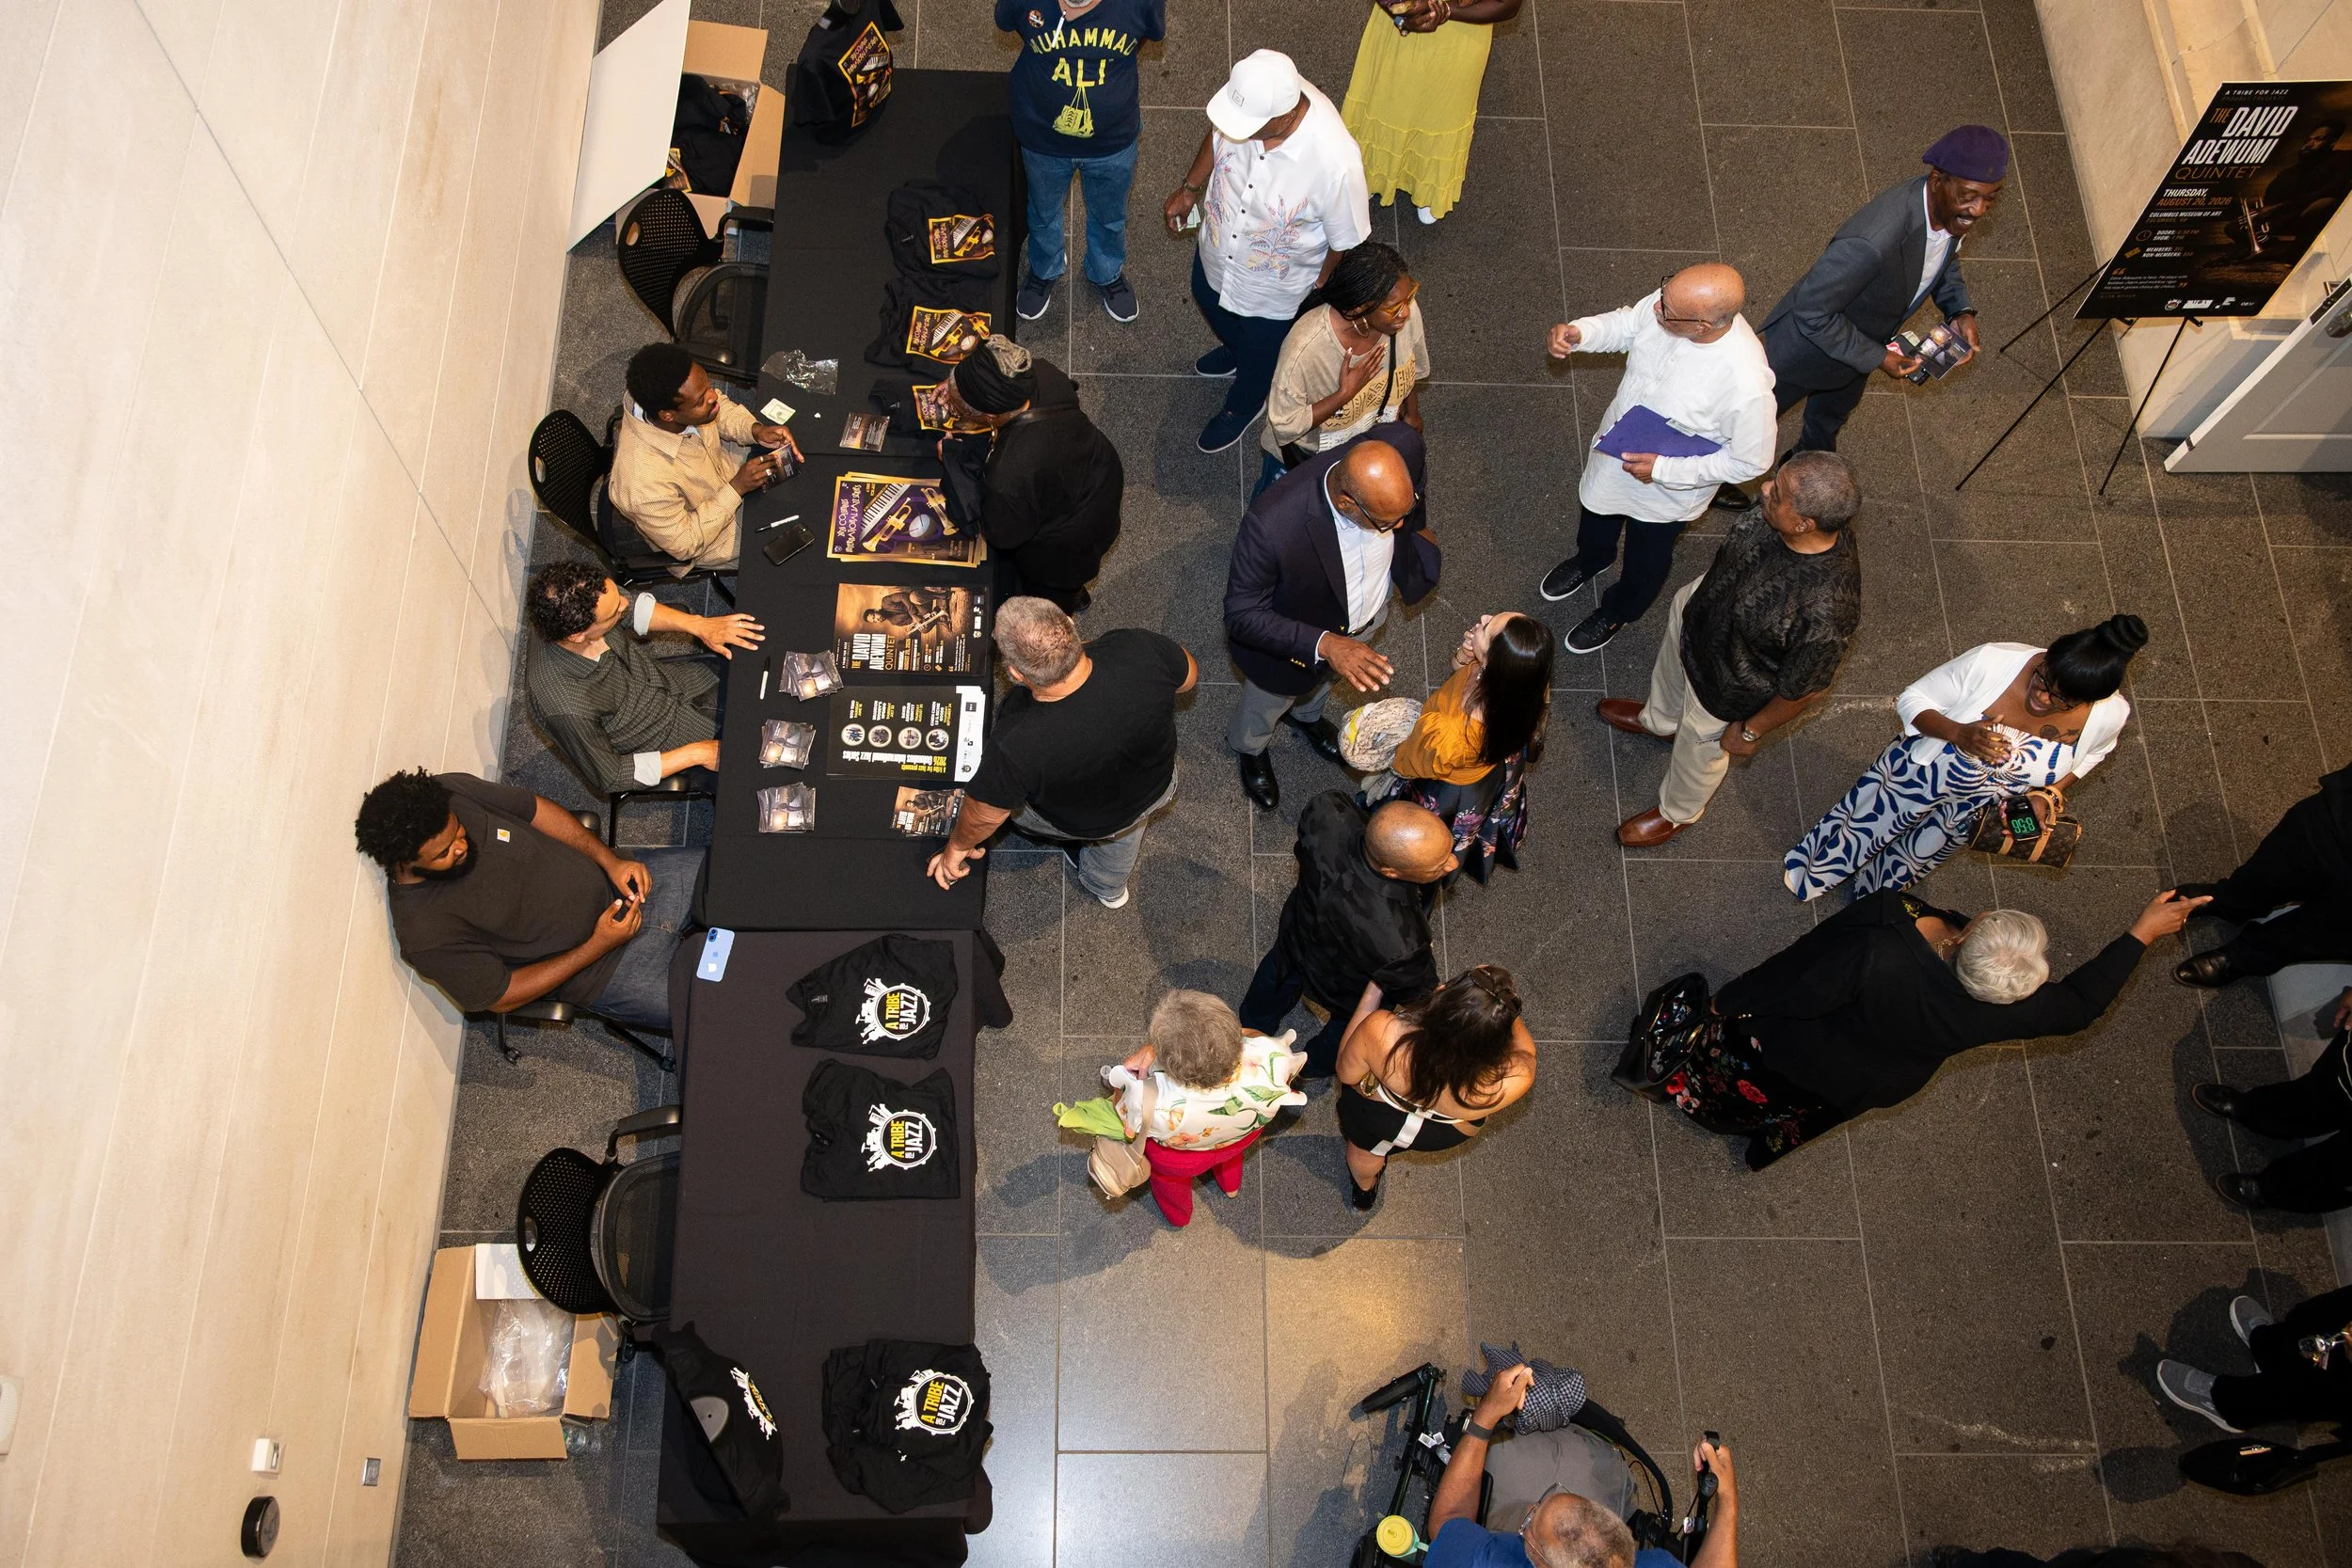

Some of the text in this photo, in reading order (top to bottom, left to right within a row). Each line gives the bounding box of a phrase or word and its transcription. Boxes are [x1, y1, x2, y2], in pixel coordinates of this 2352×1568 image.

[1030, 28, 1137, 55] MUHAMMAD
[1052, 57, 1106, 87] ALI
[2210, 106, 2298, 137] THE DAVID
[2182, 139, 2279, 164] ADEWUMI
[2175, 166, 2261, 180] QUINTET
[2163, 188, 2209, 198] THURSDAY,
[2192, 198, 2205, 206] 20,
[852, 634, 871, 660] DAVID
[869, 634, 886, 670] ADEWUMI
[884, 635, 896, 670] QUINTET
[843, 751, 860, 762] Series
[860, 752, 872, 762] Jazz
[871, 752, 906, 764] International
[933, 756, 946, 766] 2026
[2011, 817, 2035, 833] 8:56
[886, 992, 899, 1020] TRIBE
[900, 992, 917, 1024] JAZZ
[891, 1120, 904, 1148] TRIBE
[905, 1121, 922, 1153] JAZZ
[920, 1380, 945, 1424] A TRIBE
[937, 1385, 962, 1422] JAZZ
